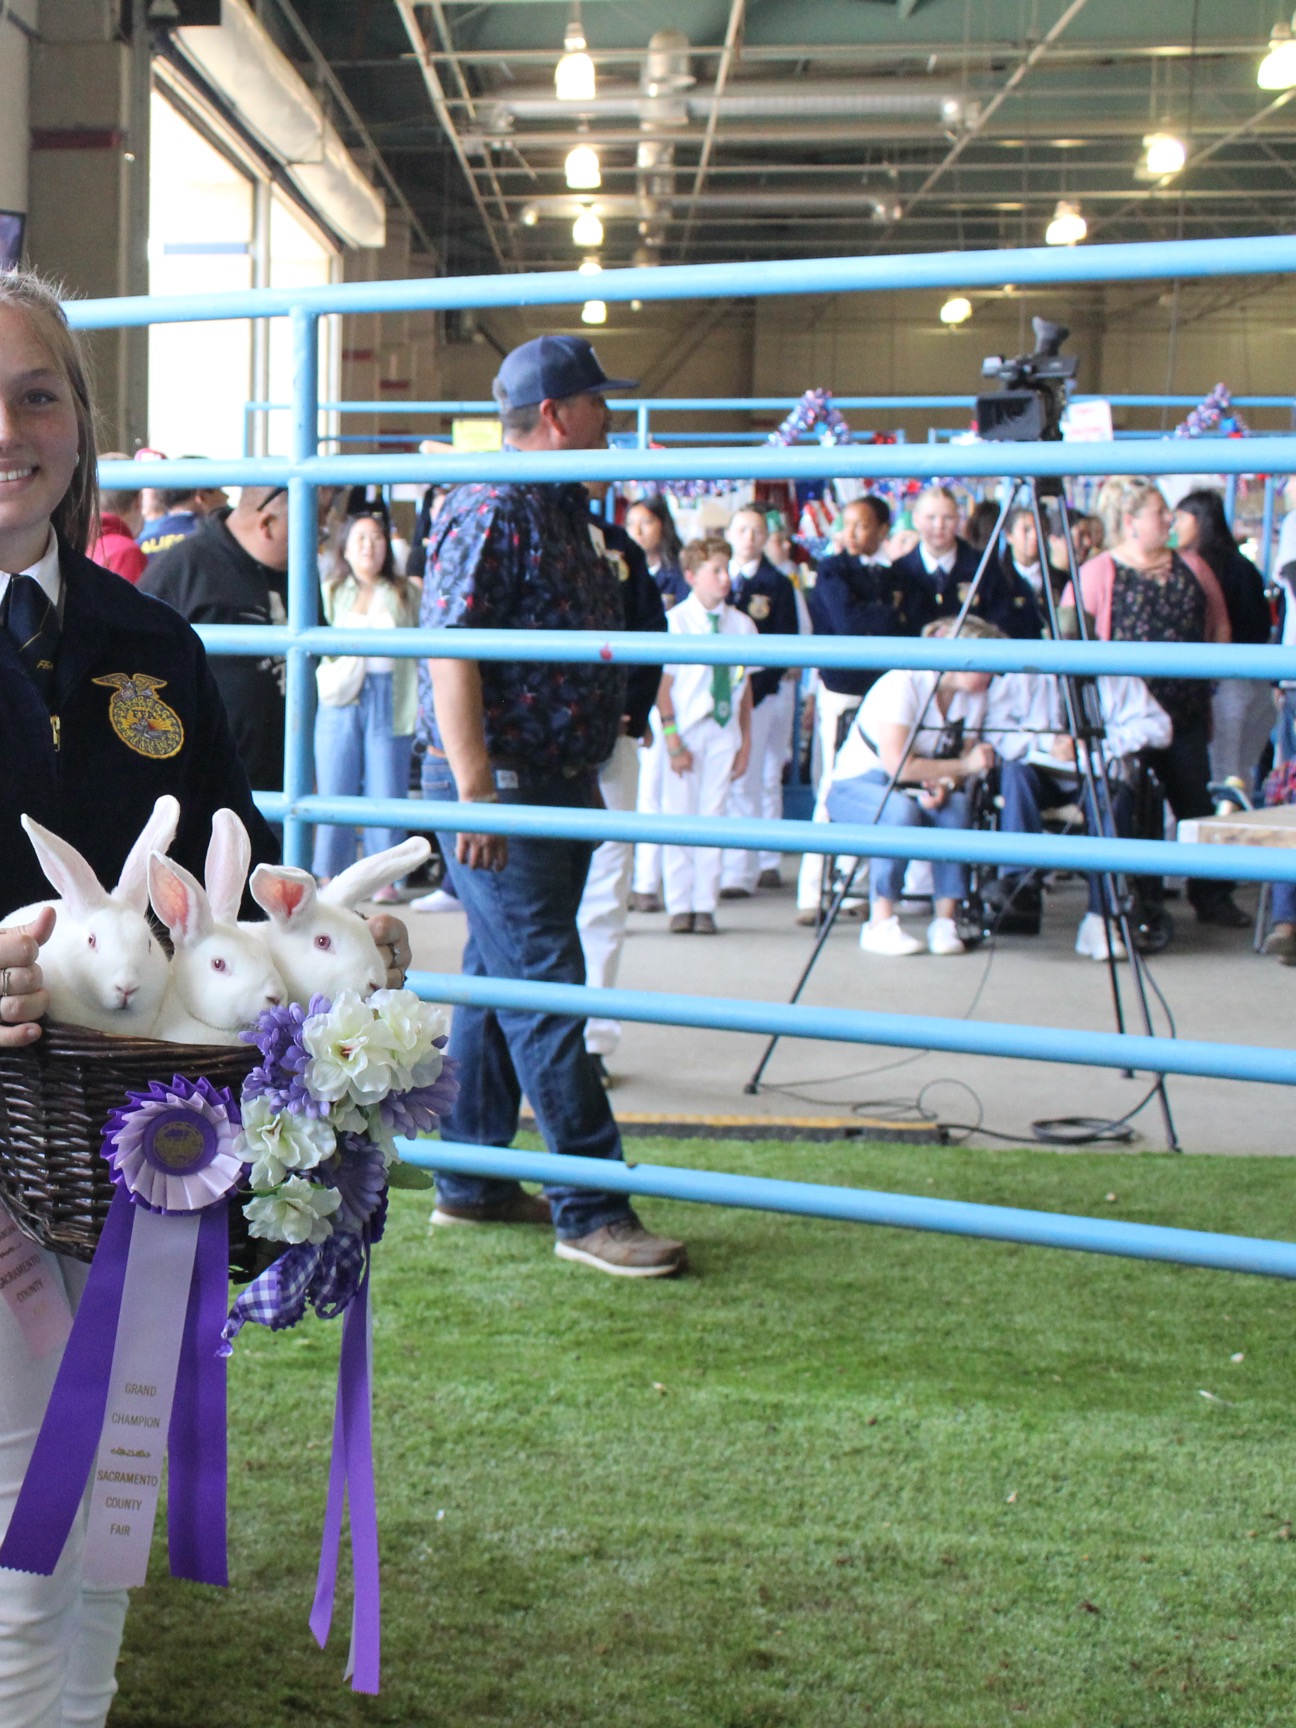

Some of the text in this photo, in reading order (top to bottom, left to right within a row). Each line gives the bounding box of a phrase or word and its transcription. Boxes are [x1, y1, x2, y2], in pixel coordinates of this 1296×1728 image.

[16, 1278, 44, 1303] COUNTY
[124, 1382, 157, 1398] GRAND
[111, 1412, 161, 1429] CHAMPION
[96, 1469, 158, 1487] SACRAMENTO
[105, 1496, 143, 1512] COUNTY
[109, 1522, 131, 1537] FAIR
